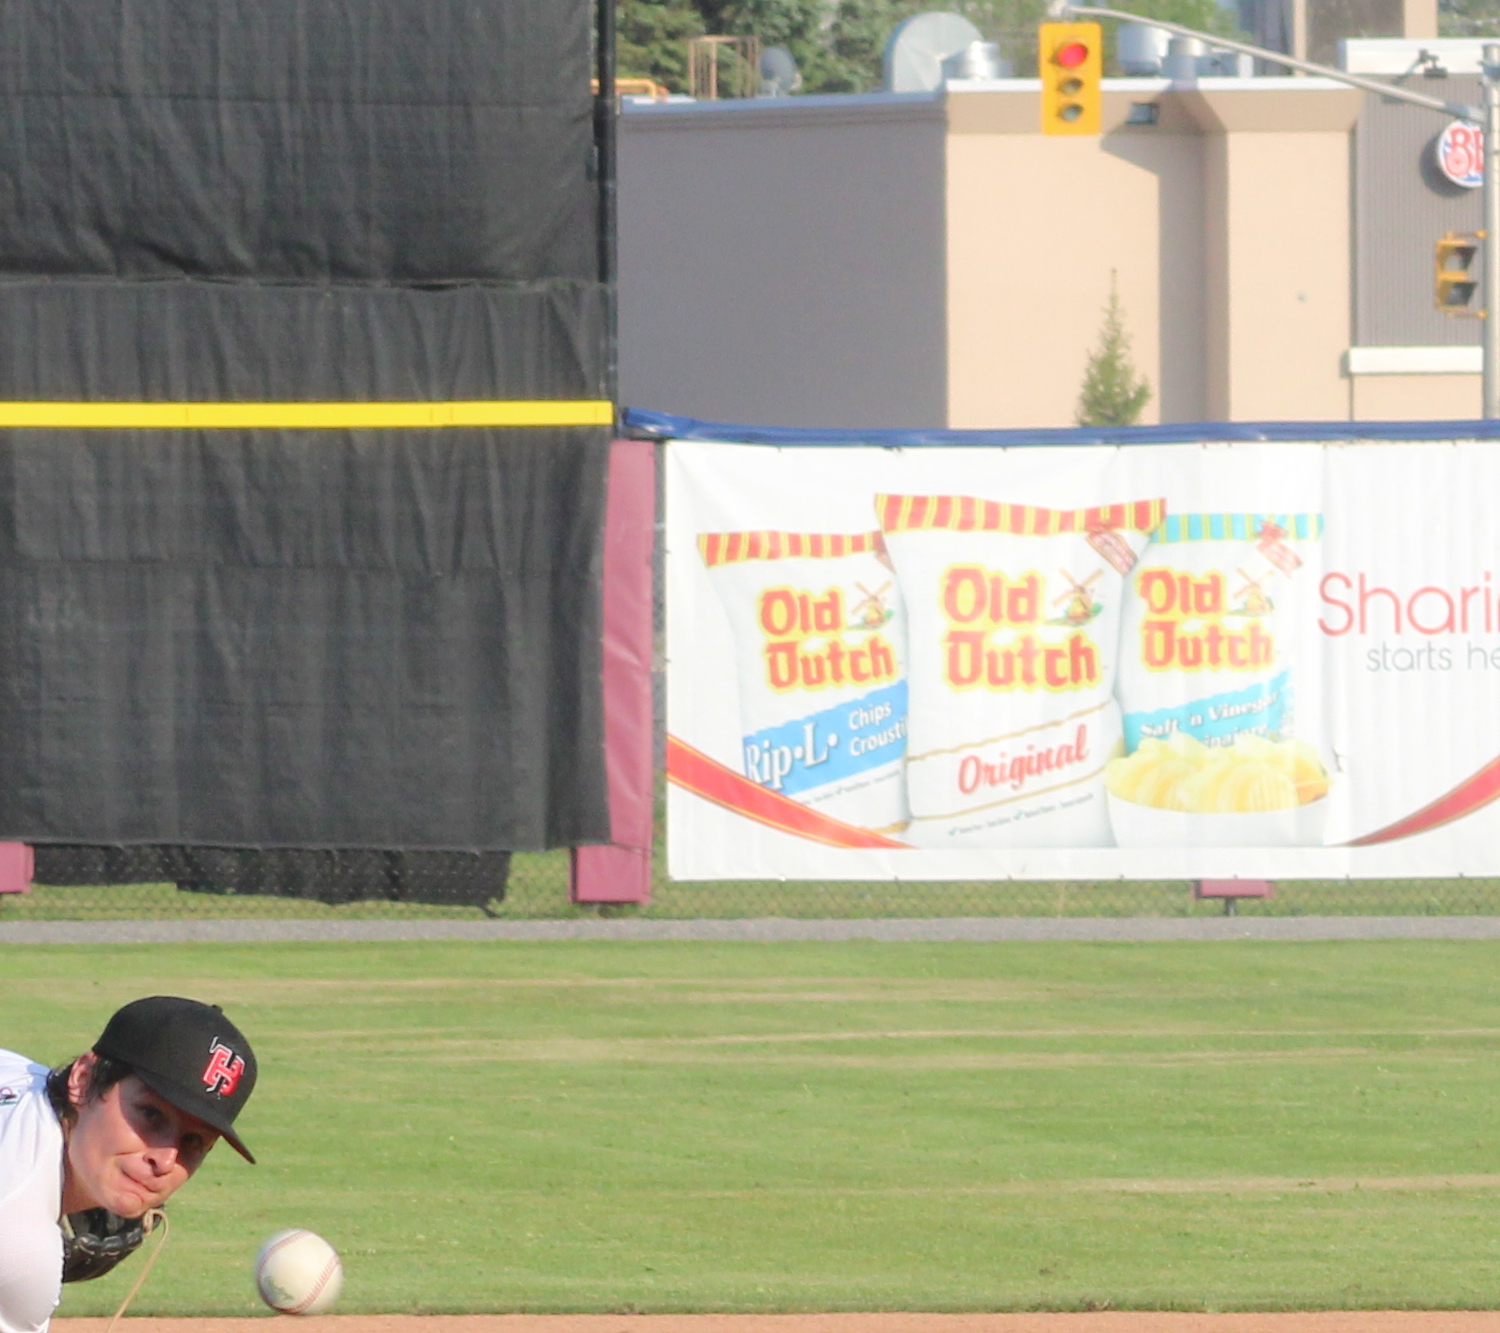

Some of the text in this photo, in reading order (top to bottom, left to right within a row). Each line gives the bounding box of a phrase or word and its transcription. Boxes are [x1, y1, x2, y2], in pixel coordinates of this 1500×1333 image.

[760, 588, 842, 637] Old
[943, 567, 1039, 623] Old
[1138, 570, 1222, 614] Old
[766, 636, 896, 689] Dutch
[945, 629, 1097, 687] Dutch
[1142, 620, 1273, 667] Dutch
[1366, 640, 1452, 672] starts
[849, 702, 893, 730] Chips
[1140, 718, 1179, 736] Salt
[1208, 690, 1281, 721] Vinegar
[958, 723, 1090, 795] Original
